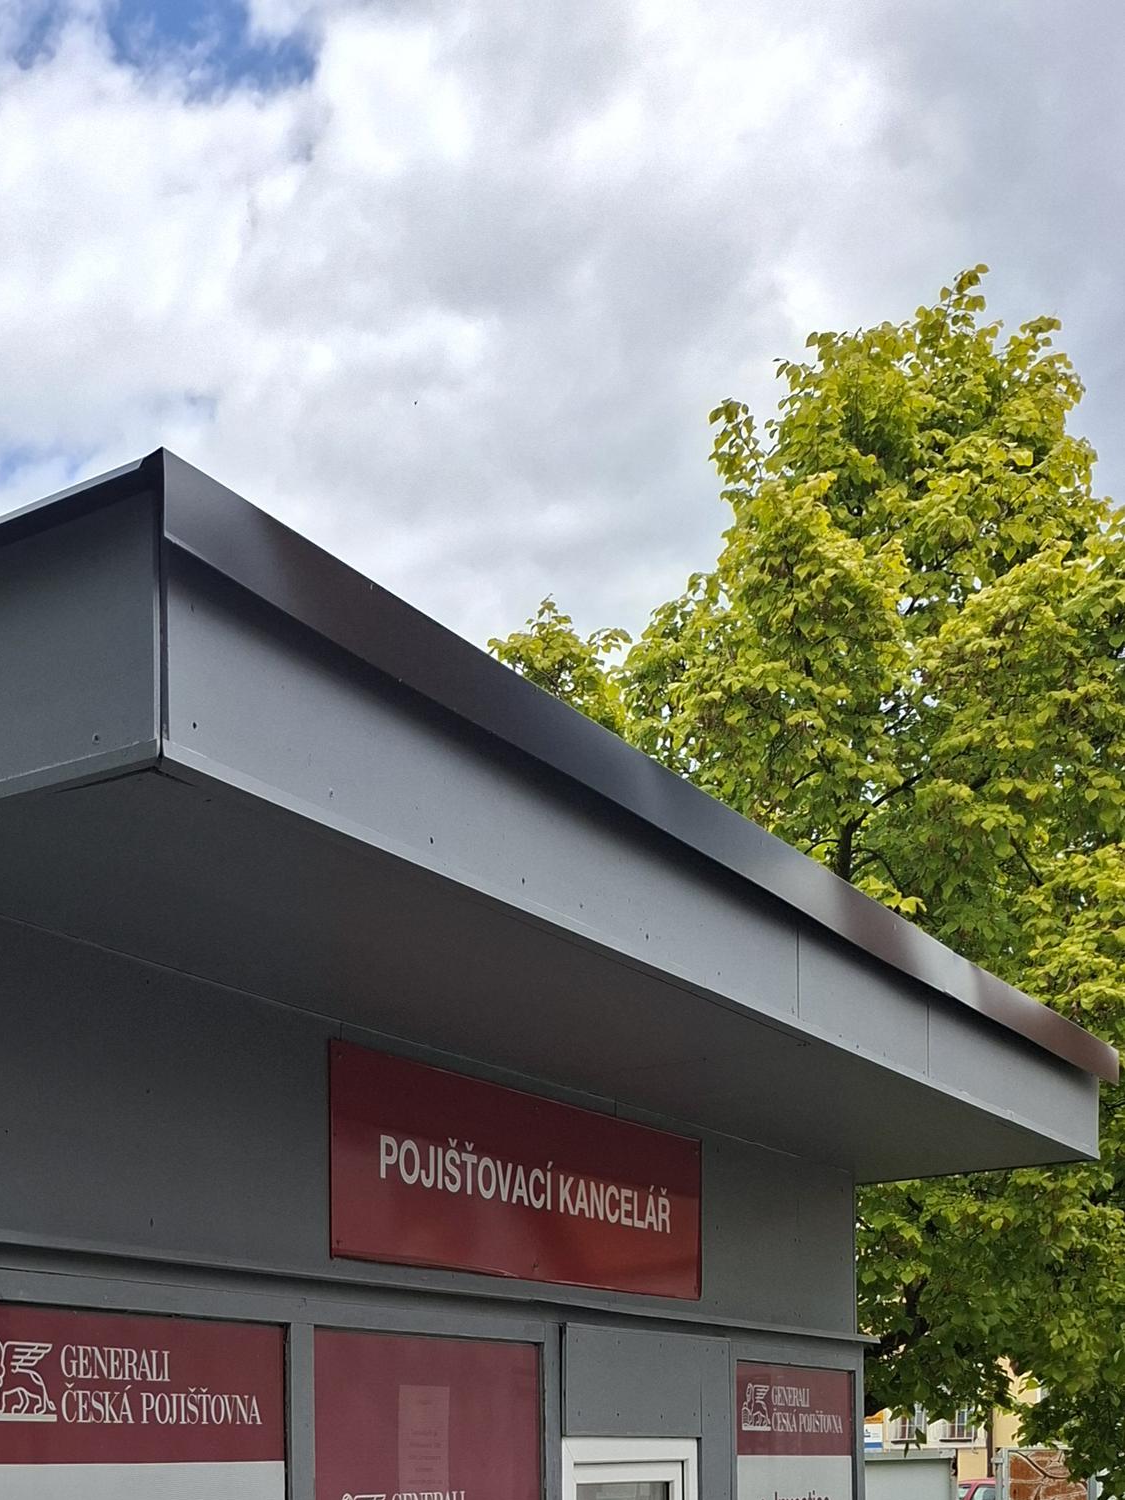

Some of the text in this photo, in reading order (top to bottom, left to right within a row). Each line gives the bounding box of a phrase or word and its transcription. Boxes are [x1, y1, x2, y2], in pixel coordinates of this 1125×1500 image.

[379, 1134, 671, 1234] POJIŠŤOVACÍ KANCELÁŘ
[60, 1343, 171, 1382] GENERALI
[61, 1382, 263, 1426] ČESKÁ POJIŠŤOVNA
[771, 1385, 810, 1408] GENERALI
[771, 1408, 798, 1433] ČESKÁ
